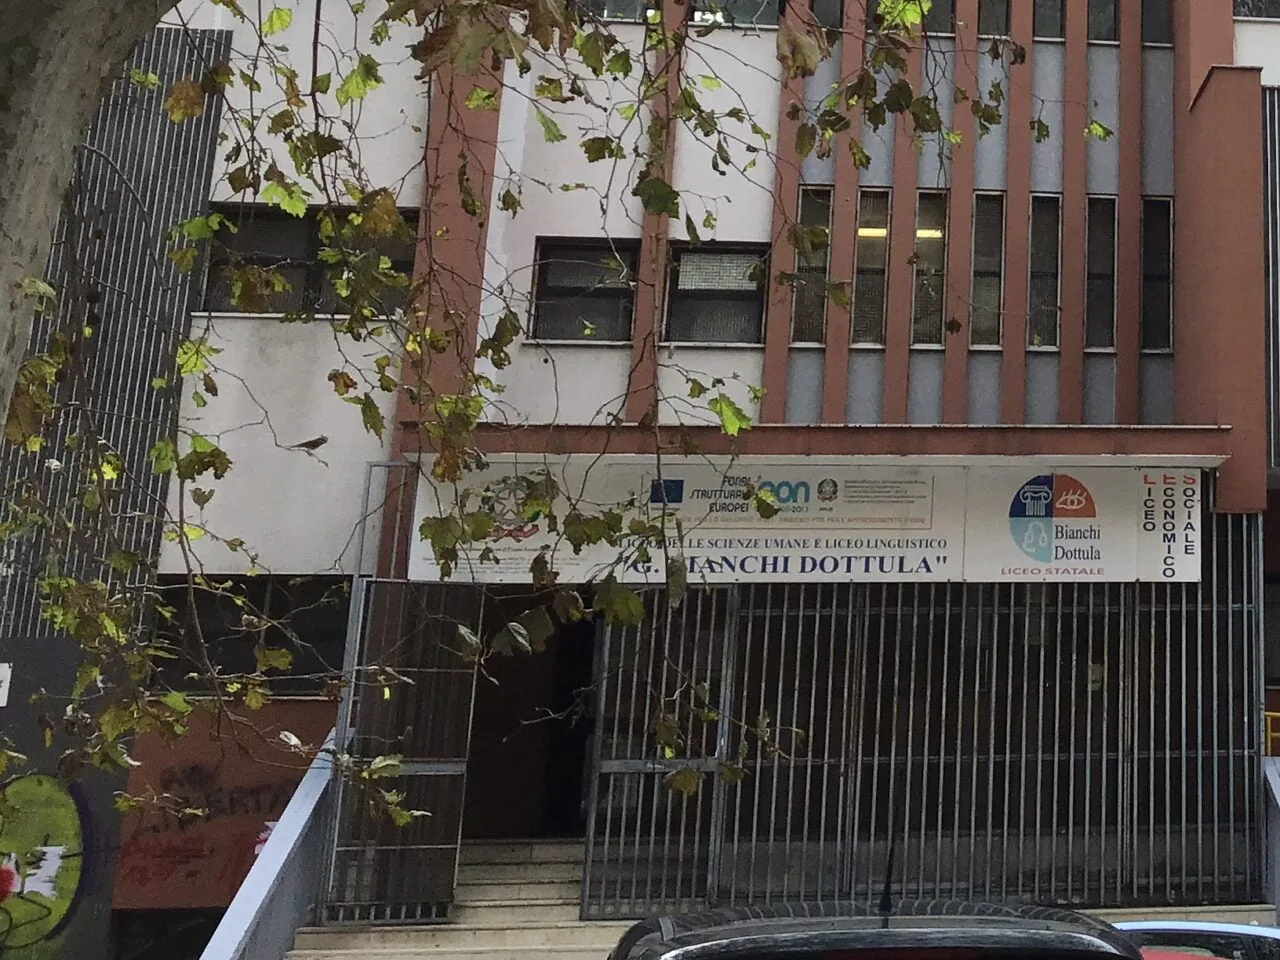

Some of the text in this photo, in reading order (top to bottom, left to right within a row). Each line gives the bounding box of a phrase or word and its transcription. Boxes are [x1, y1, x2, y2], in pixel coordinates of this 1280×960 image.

[709, 502, 749, 513] EUROPEI
[1143, 474, 1156, 531] LICEO
[1182, 474, 1196, 555] SOCIALE
[1054, 524, 1101, 540] Bianchi
[1162, 474, 1176, 578] ECONOMICO
[707, 538, 761, 549] SCIENZE
[764, 538, 810, 549] UMANE
[825, 538, 864, 549] LICEO
[866, 538, 948, 549] LINGUISTICO
[1054, 545, 1101, 560] Dottula
[799, 555, 948, 574] DOTTULA"
[1001, 567, 1105, 576] LICEO STATALE
